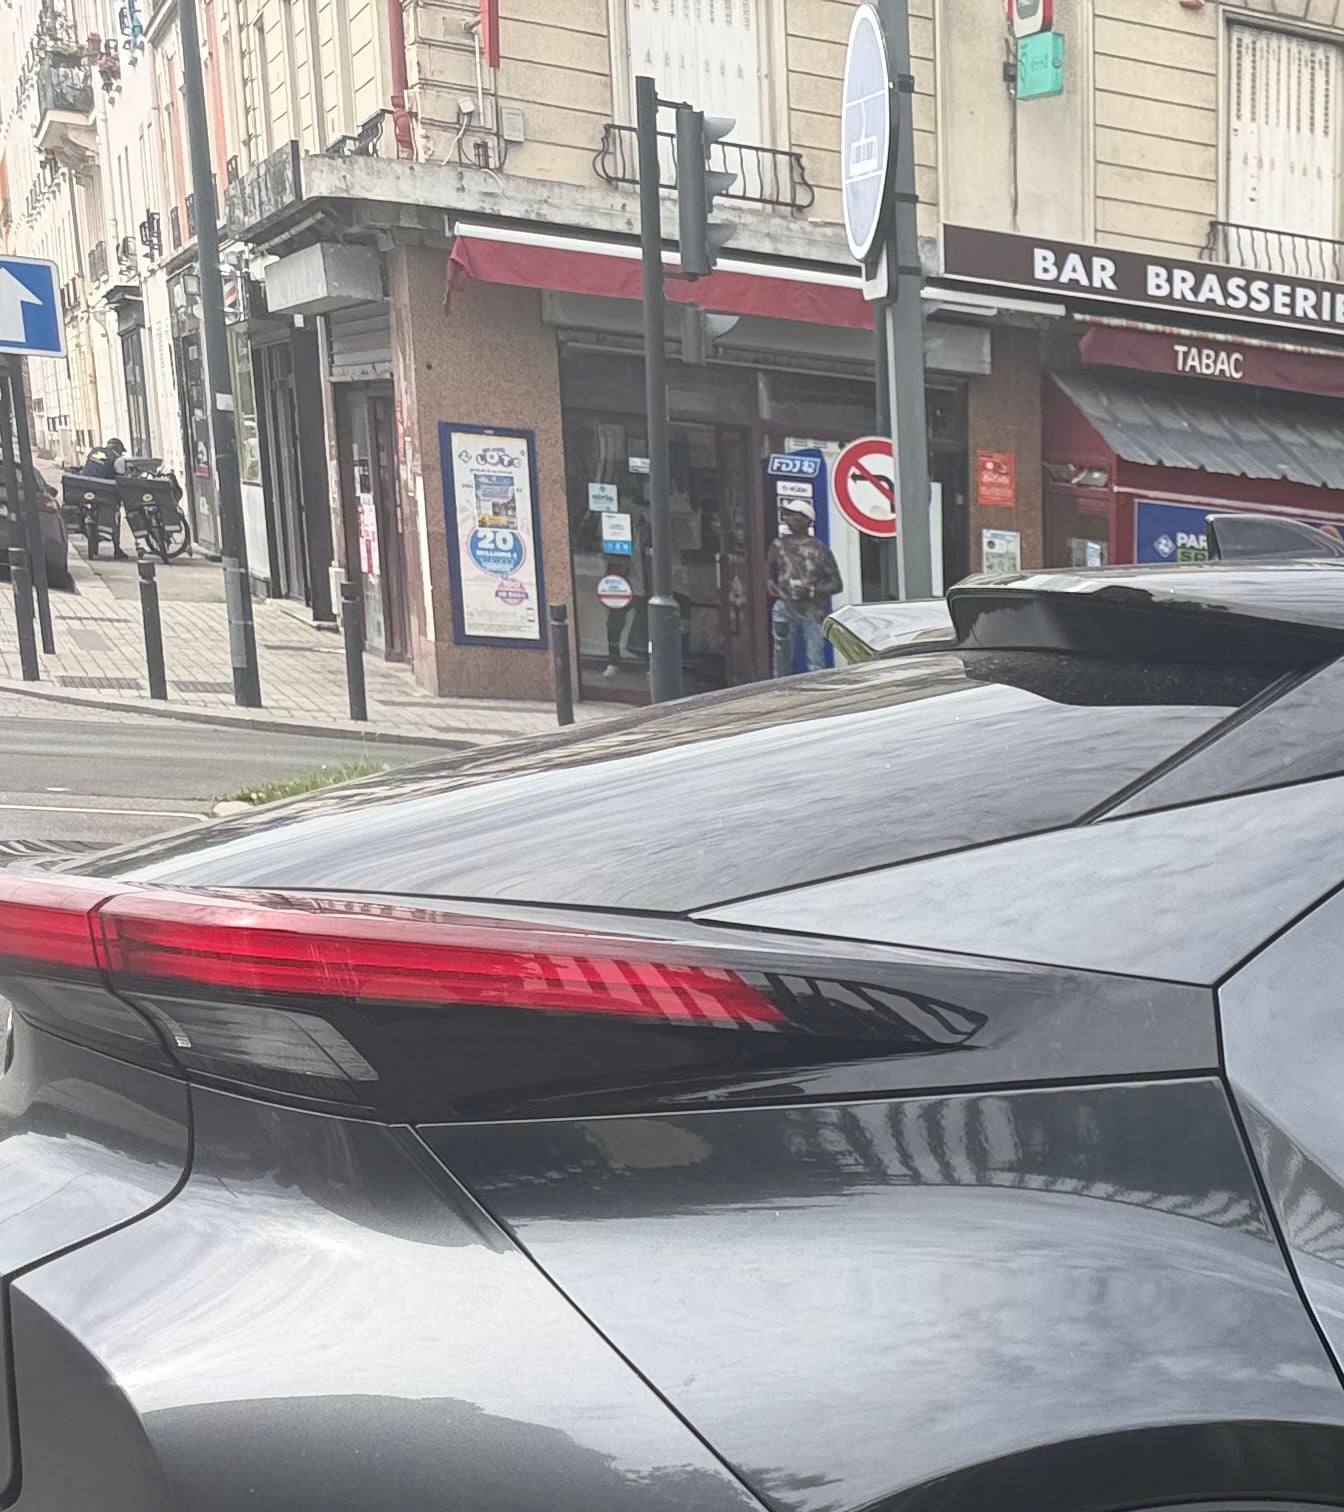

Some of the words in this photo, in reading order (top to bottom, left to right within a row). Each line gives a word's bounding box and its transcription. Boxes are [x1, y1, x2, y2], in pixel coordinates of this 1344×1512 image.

[1033, 247, 1118, 290] BAR
[1173, 344, 1244, 380] TABAC
[772, 458, 801, 473] FDJ
[477, 530, 514, 551] 20
